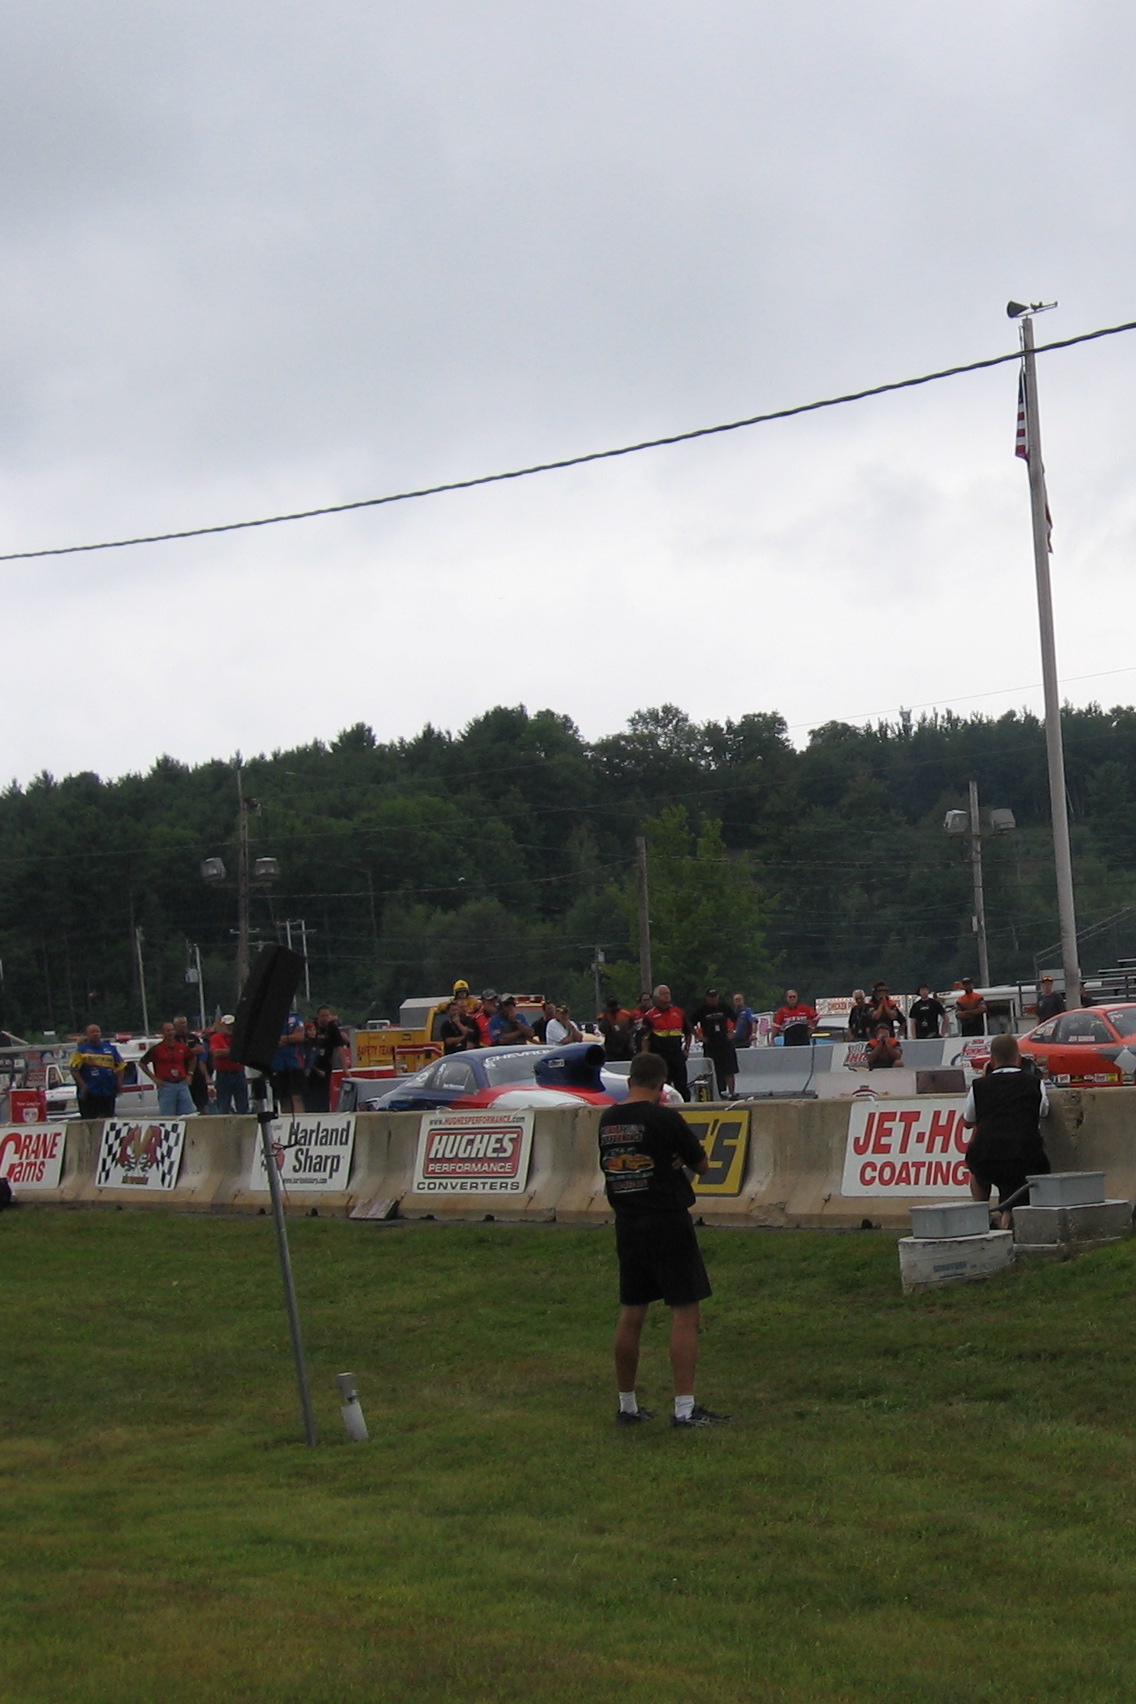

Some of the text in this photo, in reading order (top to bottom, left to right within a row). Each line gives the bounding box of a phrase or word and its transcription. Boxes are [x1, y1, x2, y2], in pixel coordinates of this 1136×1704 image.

[486, 1049, 552, 1062] CHEVRO
[288, 1120, 351, 1147] Harland
[853, 1109, 977, 1156] JET-HO
[428, 1133, 518, 1159] HUGHES
[292, 1147, 341, 1179] Sharp
[428, 1162, 513, 1173] PERFORMANCE
[859, 1160, 973, 1187] COATING
[416, 1181, 520, 1191] CONVERTERS
